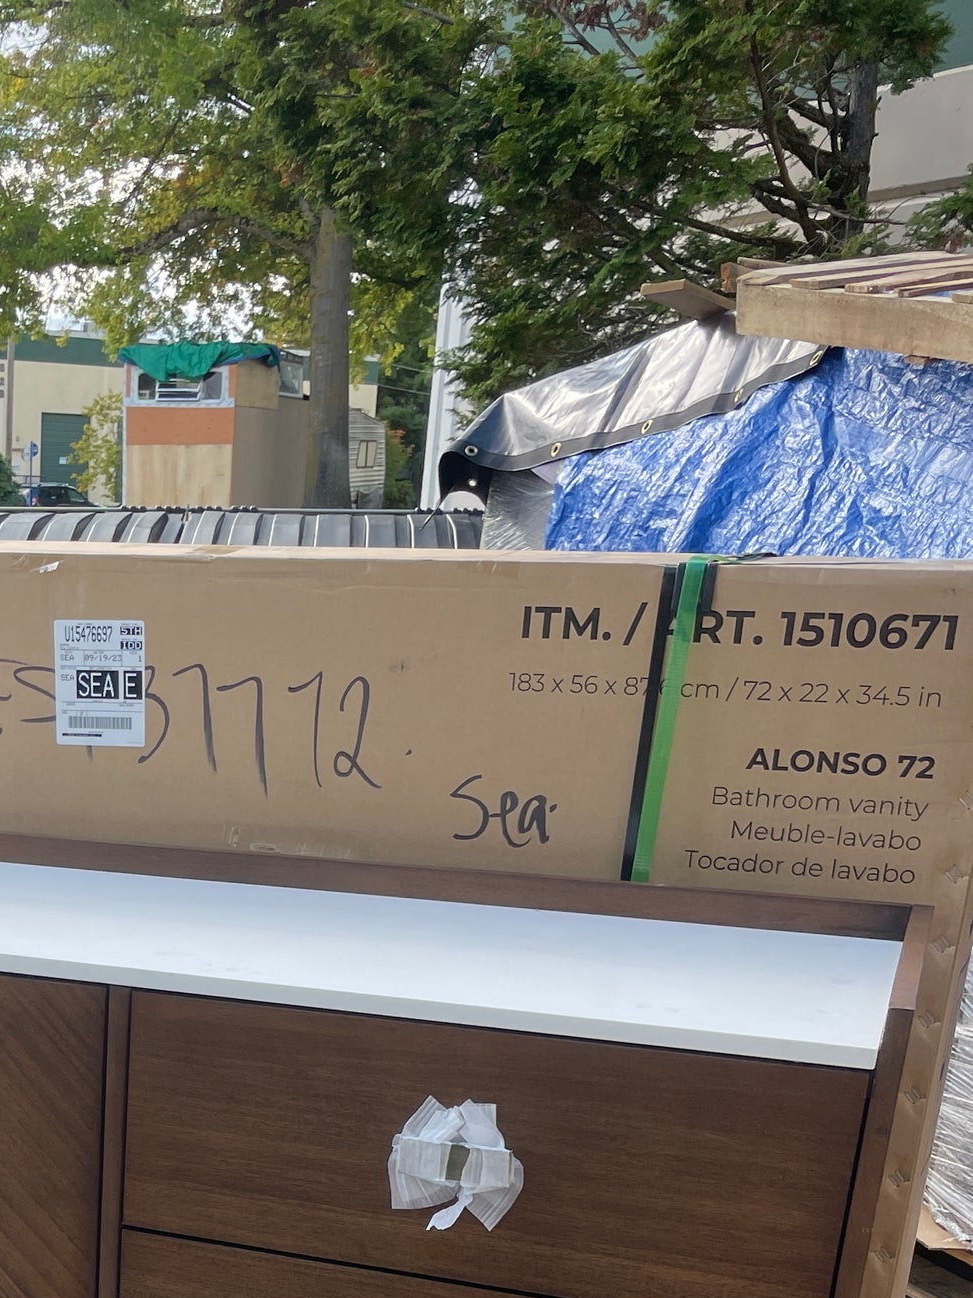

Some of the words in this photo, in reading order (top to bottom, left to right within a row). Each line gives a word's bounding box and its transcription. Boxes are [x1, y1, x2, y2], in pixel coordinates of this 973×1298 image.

[64, 626, 113, 642] U15476697
[521, 605, 611, 641] ITM.
[622, 602, 648, 646] /
[781, 611, 959, 650] 1510671
[60, 654, 75, 662] SEA
[78, 672, 115, 698] SEA
[125, 672, 137, 698] E
[509, 672, 545, 693] 183
[551, 677, 564, 693] x
[570, 674, 598, 694] 56
[604, 679, 617, 695] x
[680, 682, 720, 699] cm
[726, 677, 739, 702] /
[743, 680, 772, 700] 72
[778, 686, 792, 702] x
[799, 683, 828, 703] 22
[836, 688, 850, 704] x
[856, 684, 910, 706] 34.5
[918, 686, 941, 708] in
[745, 748, 887, 776] ALONSO
[897, 755, 935, 779] 72
[711, 786, 840, 813] Bathroom
[849, 796, 929, 822] vanity
[730, 820, 922, 851] Meuble-lavabo
[684, 849, 784, 875] Tocador
[791, 857, 823, 877] de
[831, 859, 915, 884] lavabo
